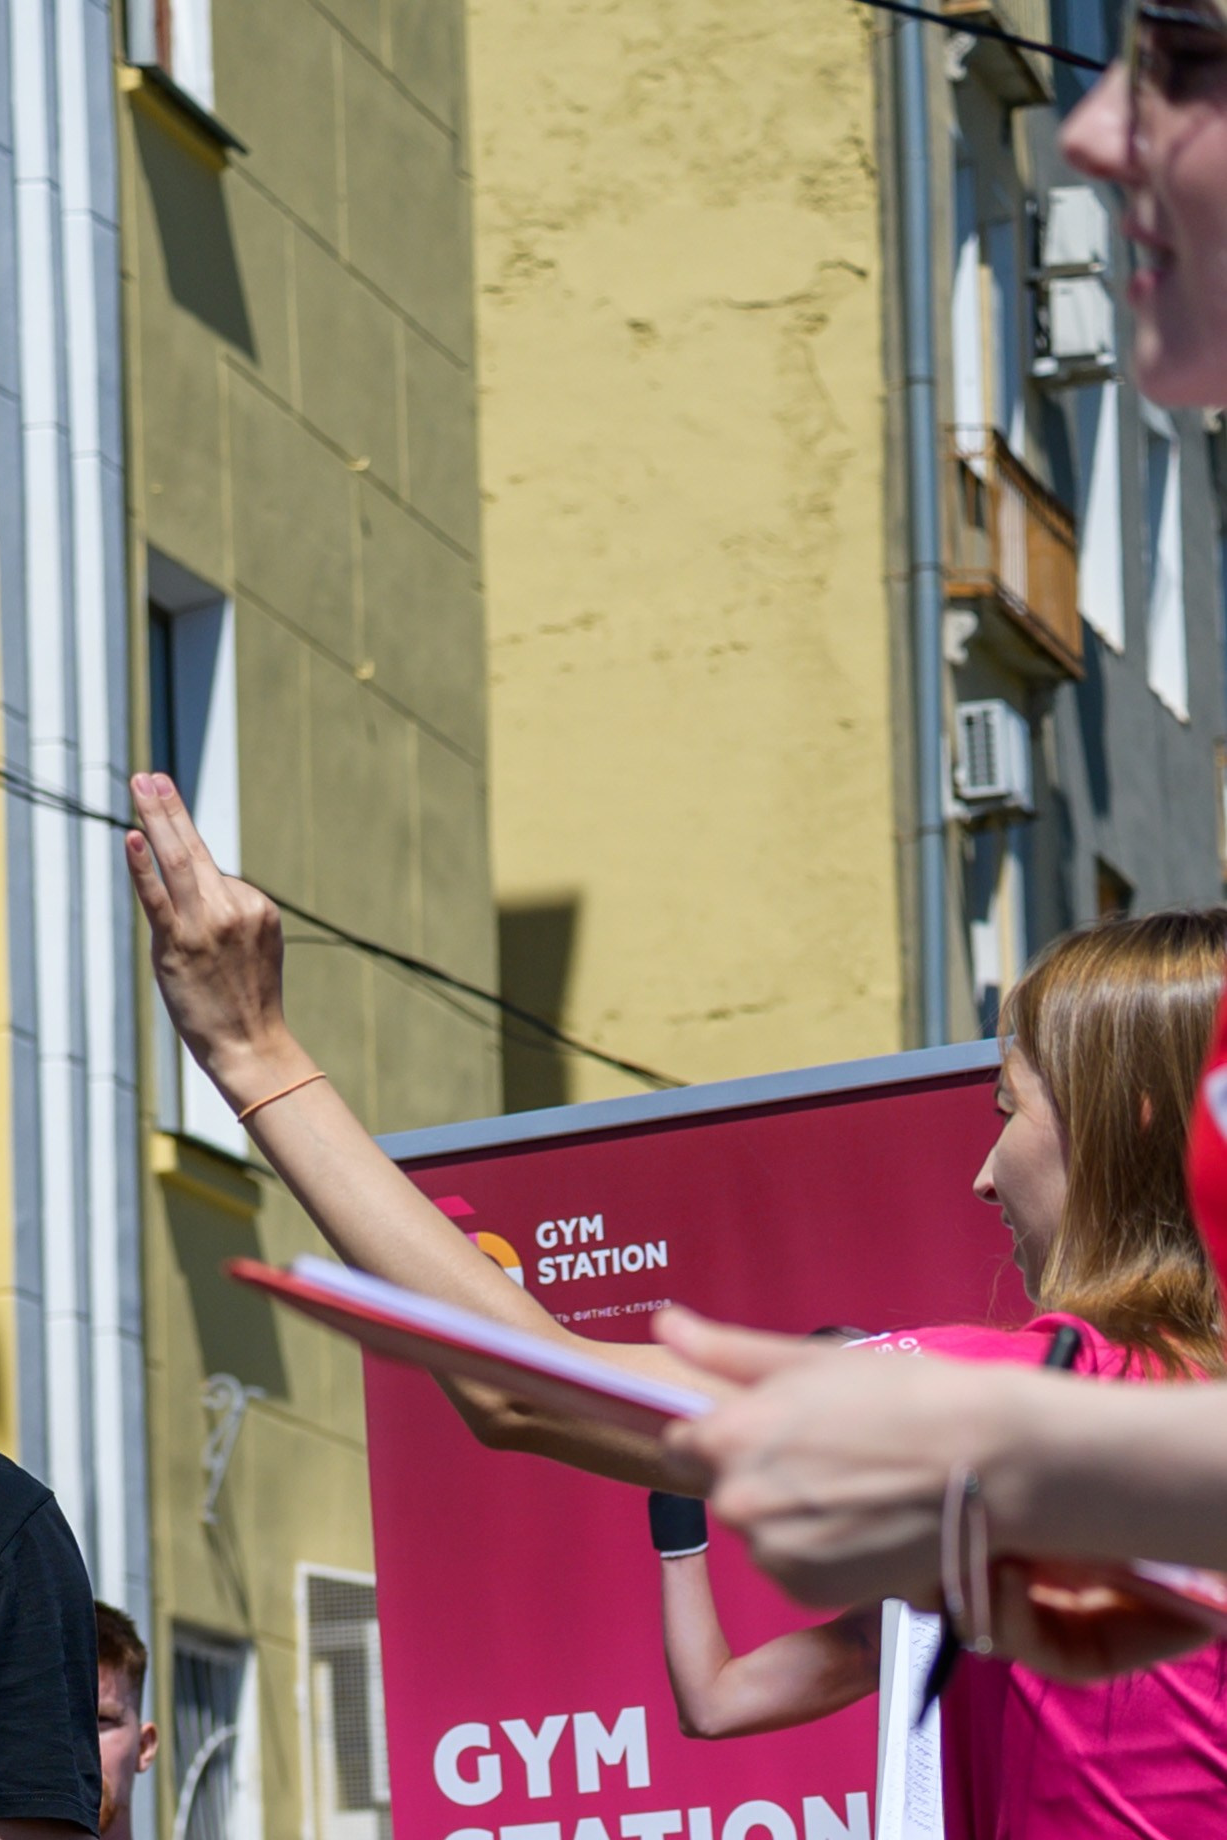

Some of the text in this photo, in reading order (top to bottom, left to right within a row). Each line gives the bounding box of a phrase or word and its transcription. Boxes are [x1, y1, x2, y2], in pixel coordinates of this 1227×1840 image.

[536, 1214, 604, 1249] GYM
[537, 1241, 668, 1284] STATION
[433, 1706, 650, 1806] GYM
